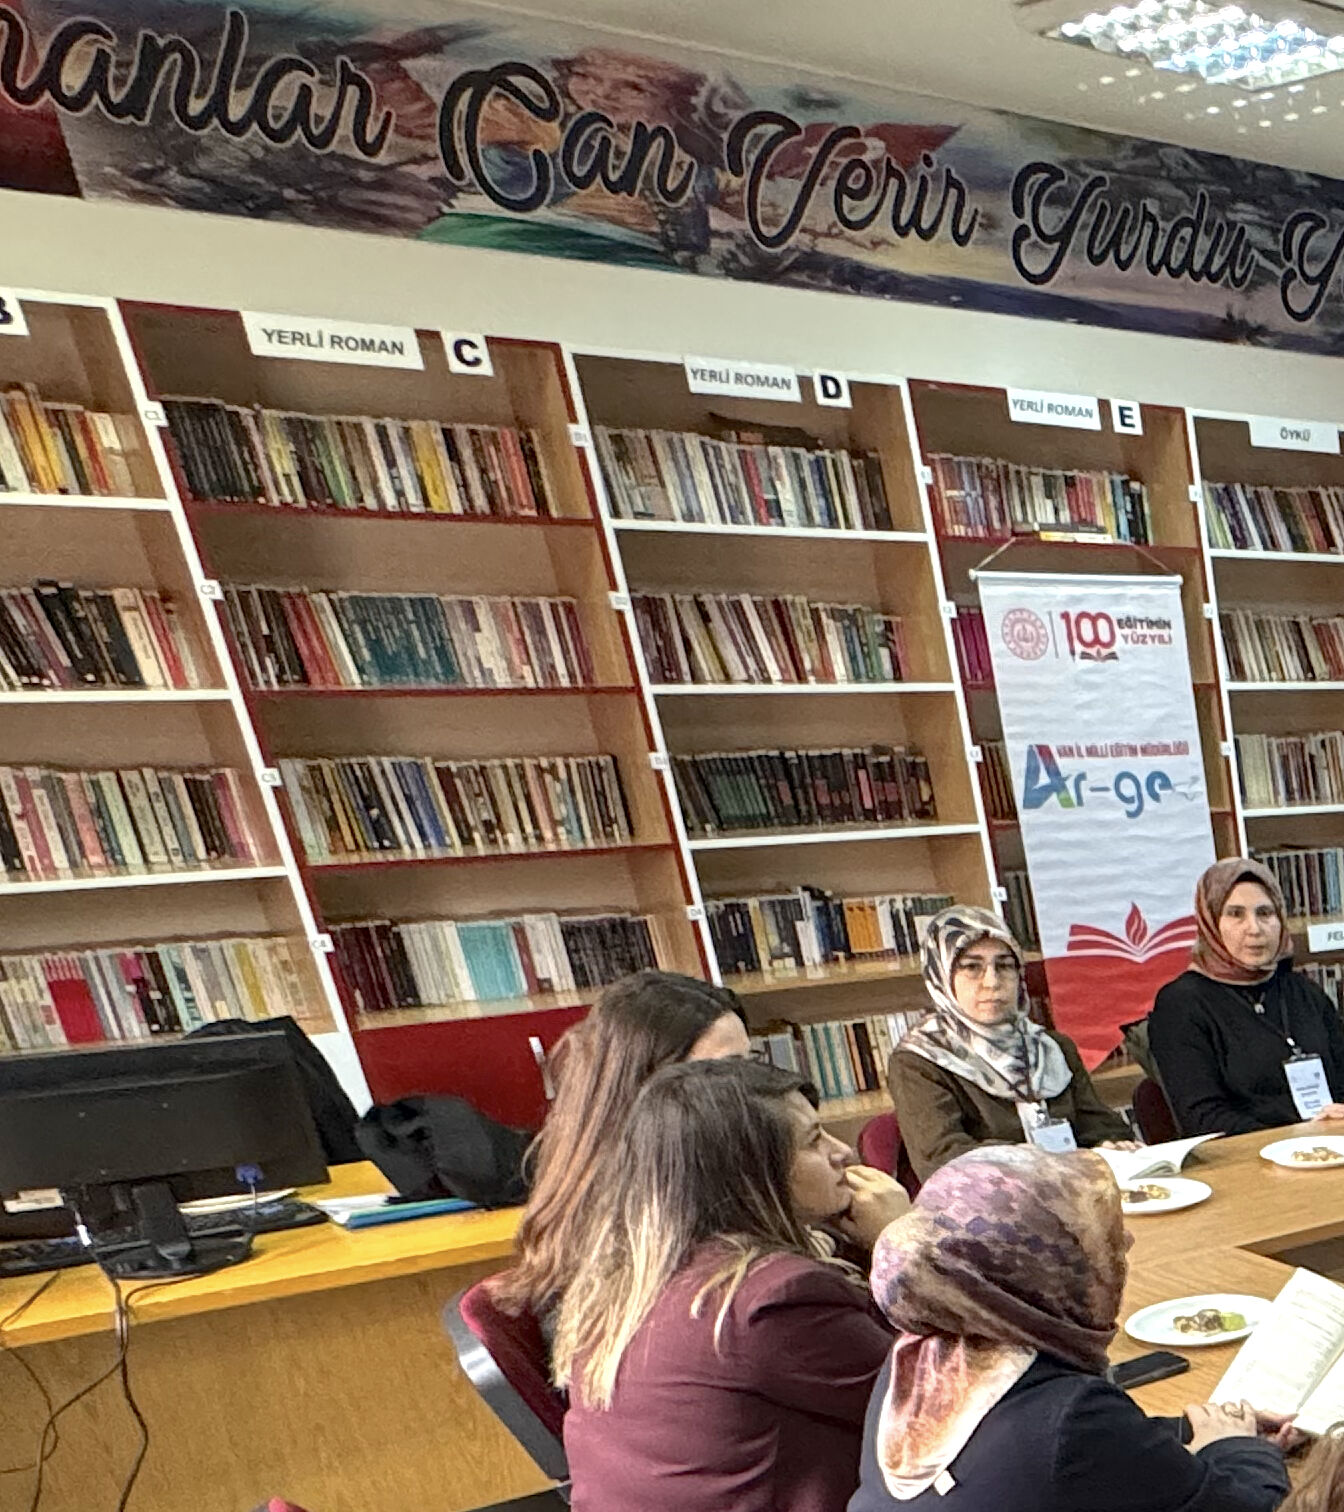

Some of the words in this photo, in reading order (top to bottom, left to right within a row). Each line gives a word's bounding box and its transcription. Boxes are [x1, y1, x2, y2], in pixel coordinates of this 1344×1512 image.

[439, 62, 694, 213] Can
[726, 109, 979, 249] Verir
[1012, 161, 1256, 285] Yurdu
[261, 327, 325, 349] YERLİ
[329, 334, 405, 356] ROMAN
[453, 338, 483, 367] C
[690, 367, 730, 386] YERLİ
[734, 371, 792, 391] ROMAN
[819, 373, 843, 401] D
[1012, 397, 1044, 414] YERLİ
[1047, 402, 1094, 420] ROMAN
[1118, 405, 1137, 430] E
[1060, 611, 1116, 661] 100
